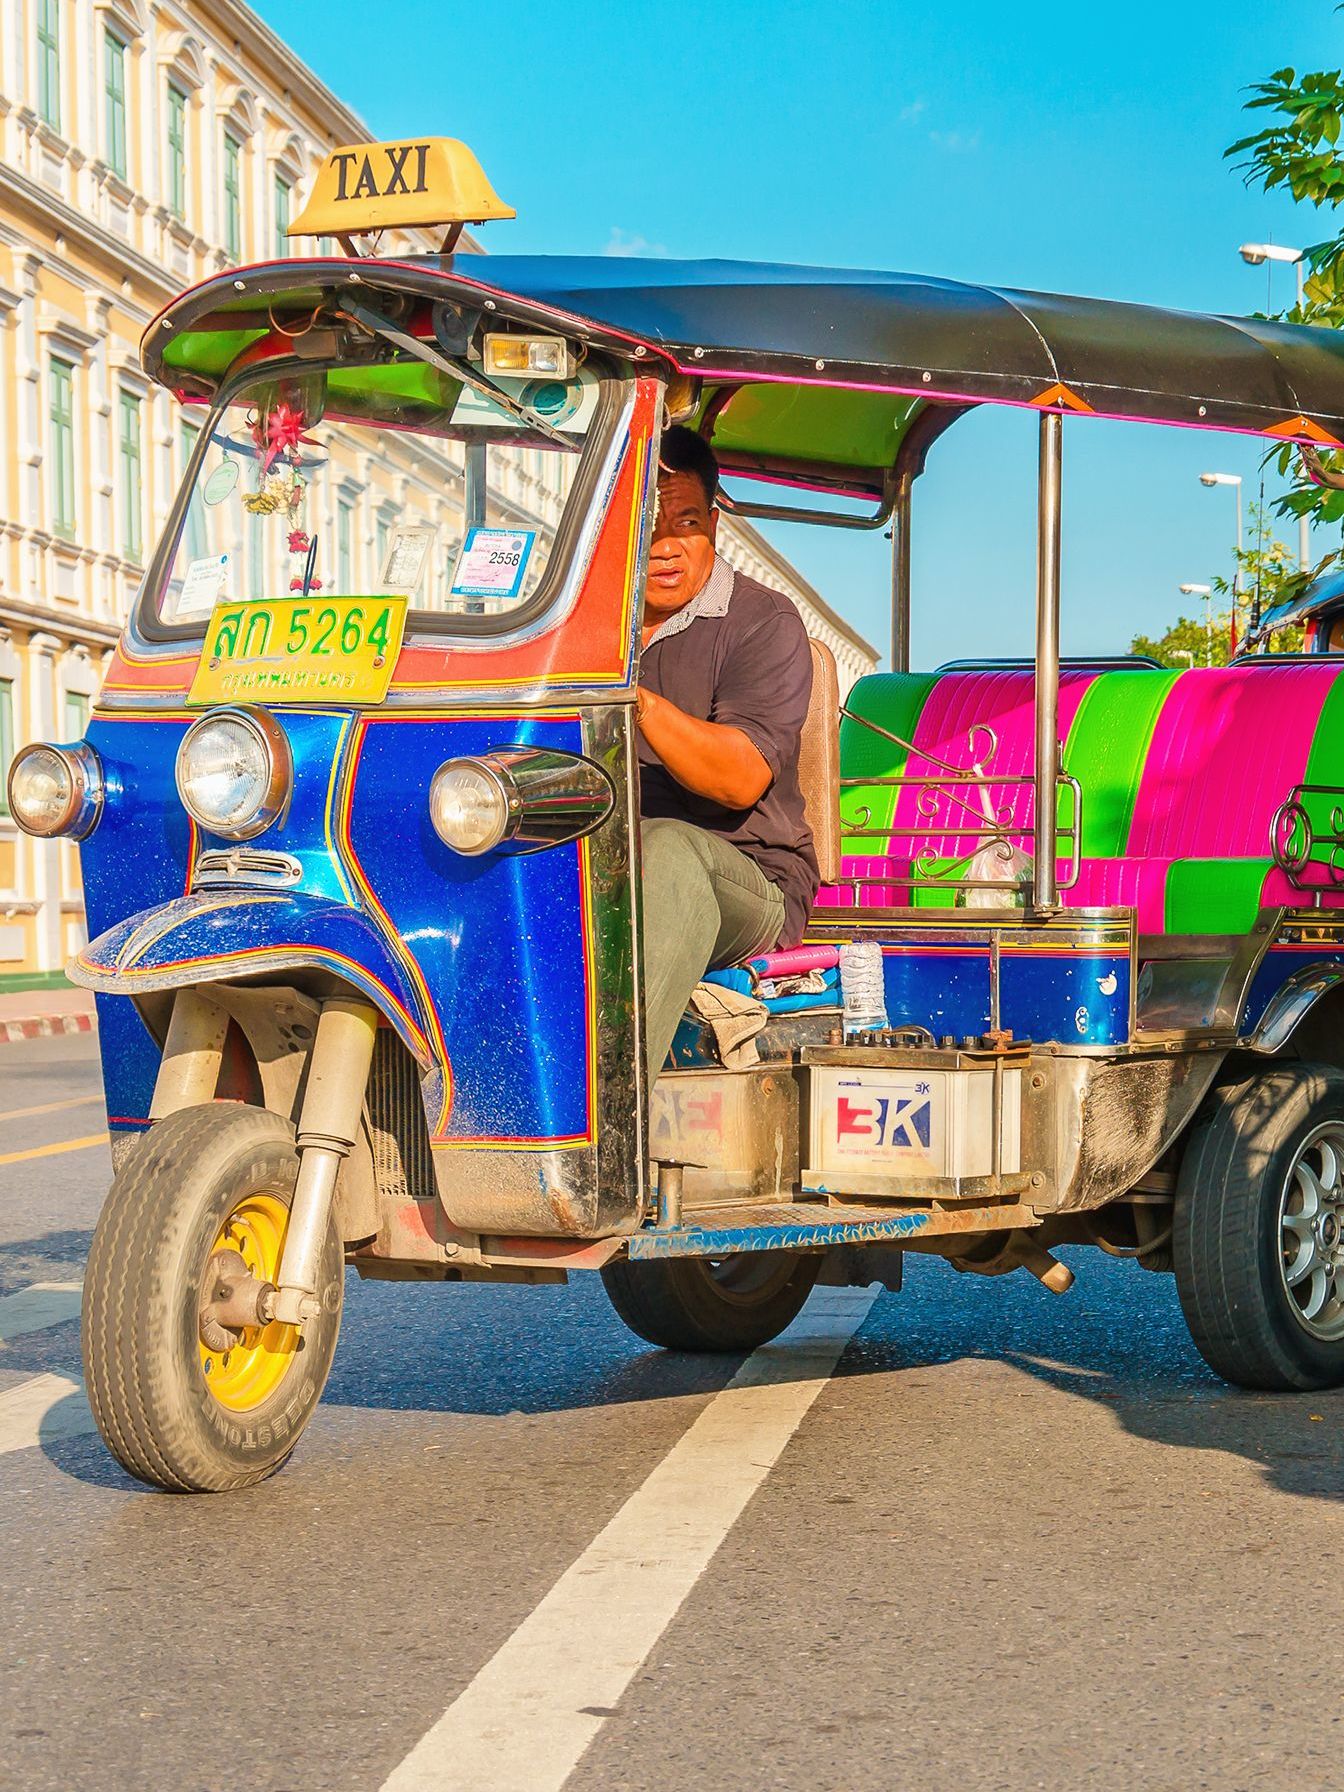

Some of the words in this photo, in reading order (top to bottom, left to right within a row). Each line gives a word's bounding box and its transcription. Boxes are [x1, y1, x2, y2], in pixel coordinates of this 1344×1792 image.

[329, 144, 431, 202] TAXI
[489, 551, 521, 567] 2558
[213, 607, 273, 658] สก
[286, 607, 394, 657] 5264
[837, 1096, 931, 1148] 3K
